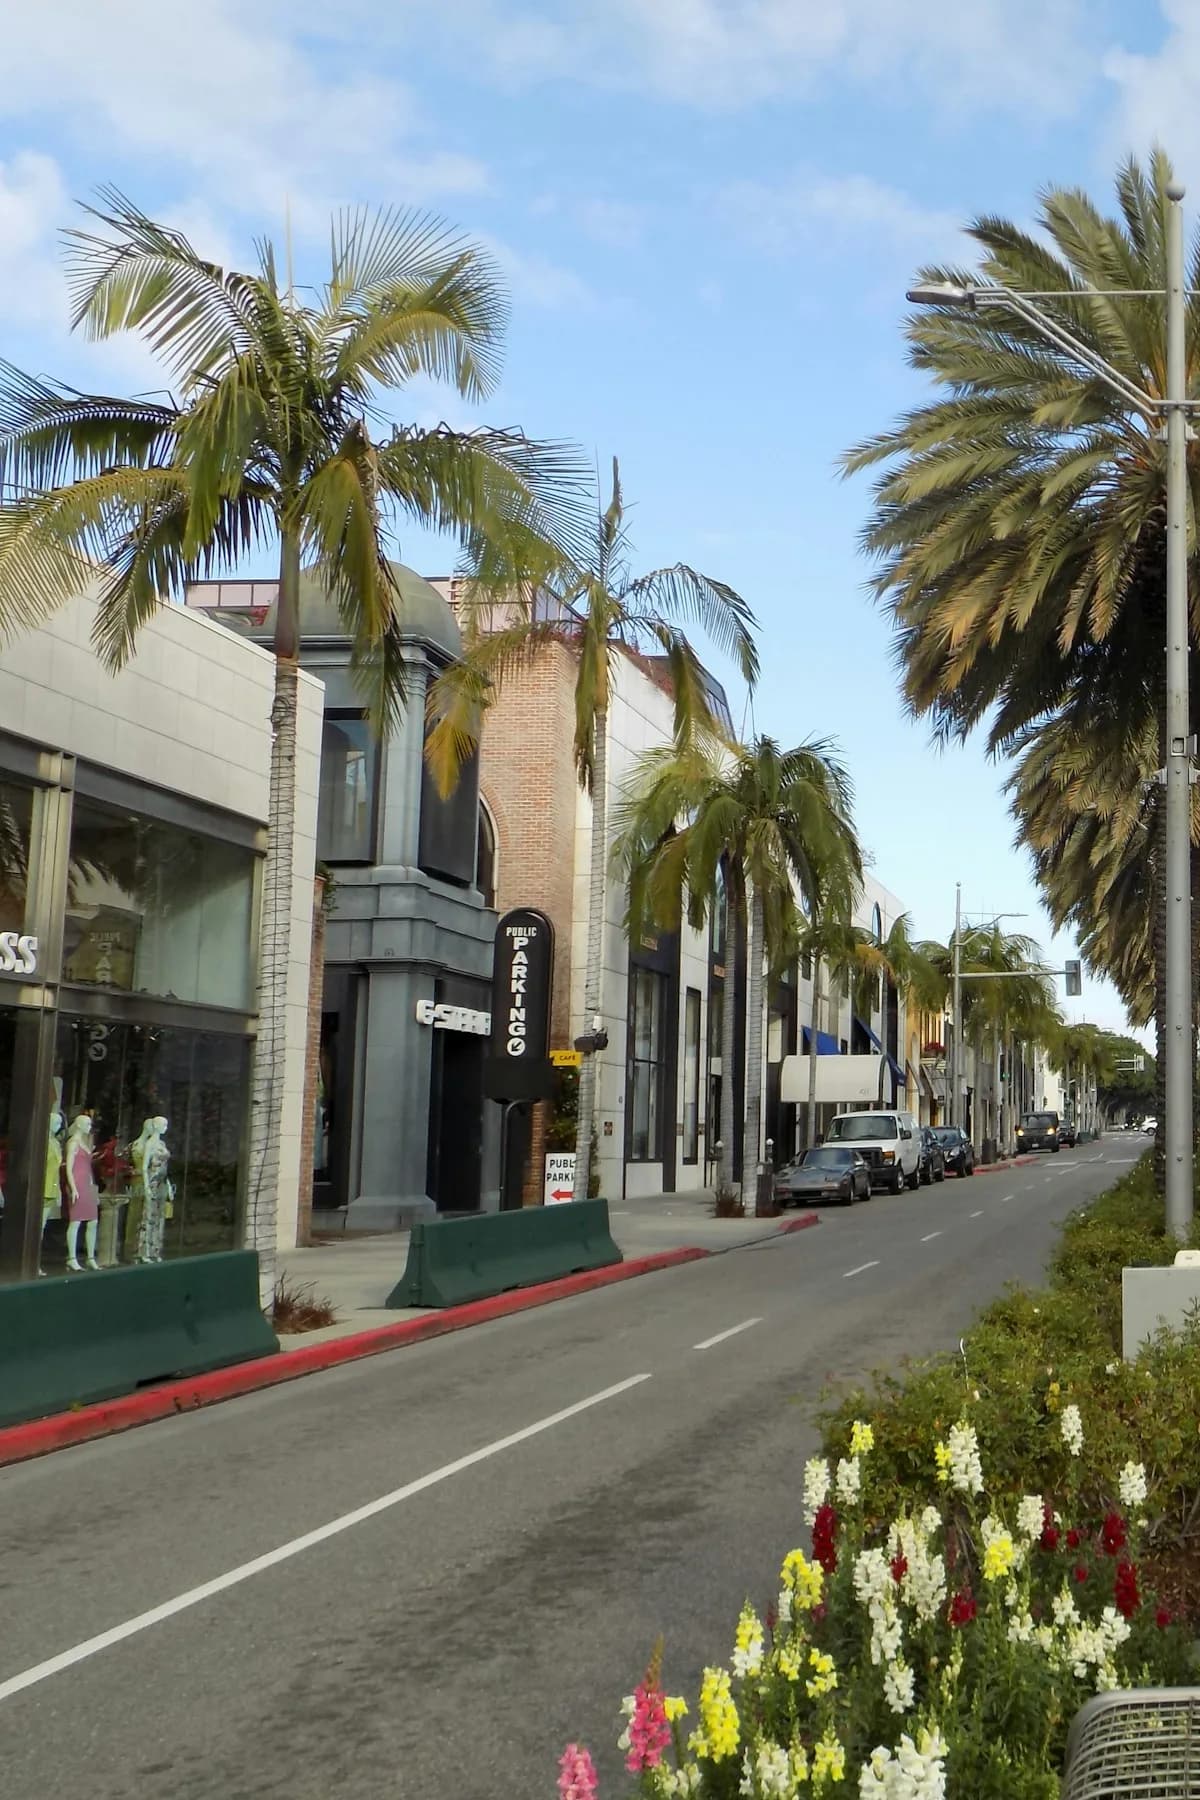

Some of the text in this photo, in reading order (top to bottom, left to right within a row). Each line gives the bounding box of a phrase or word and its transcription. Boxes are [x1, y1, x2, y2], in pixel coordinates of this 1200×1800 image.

[506, 927, 537, 937] PUBLIC
[508, 936, 529, 1036] PARKING
[549, 1159, 575, 1169] PUBL
